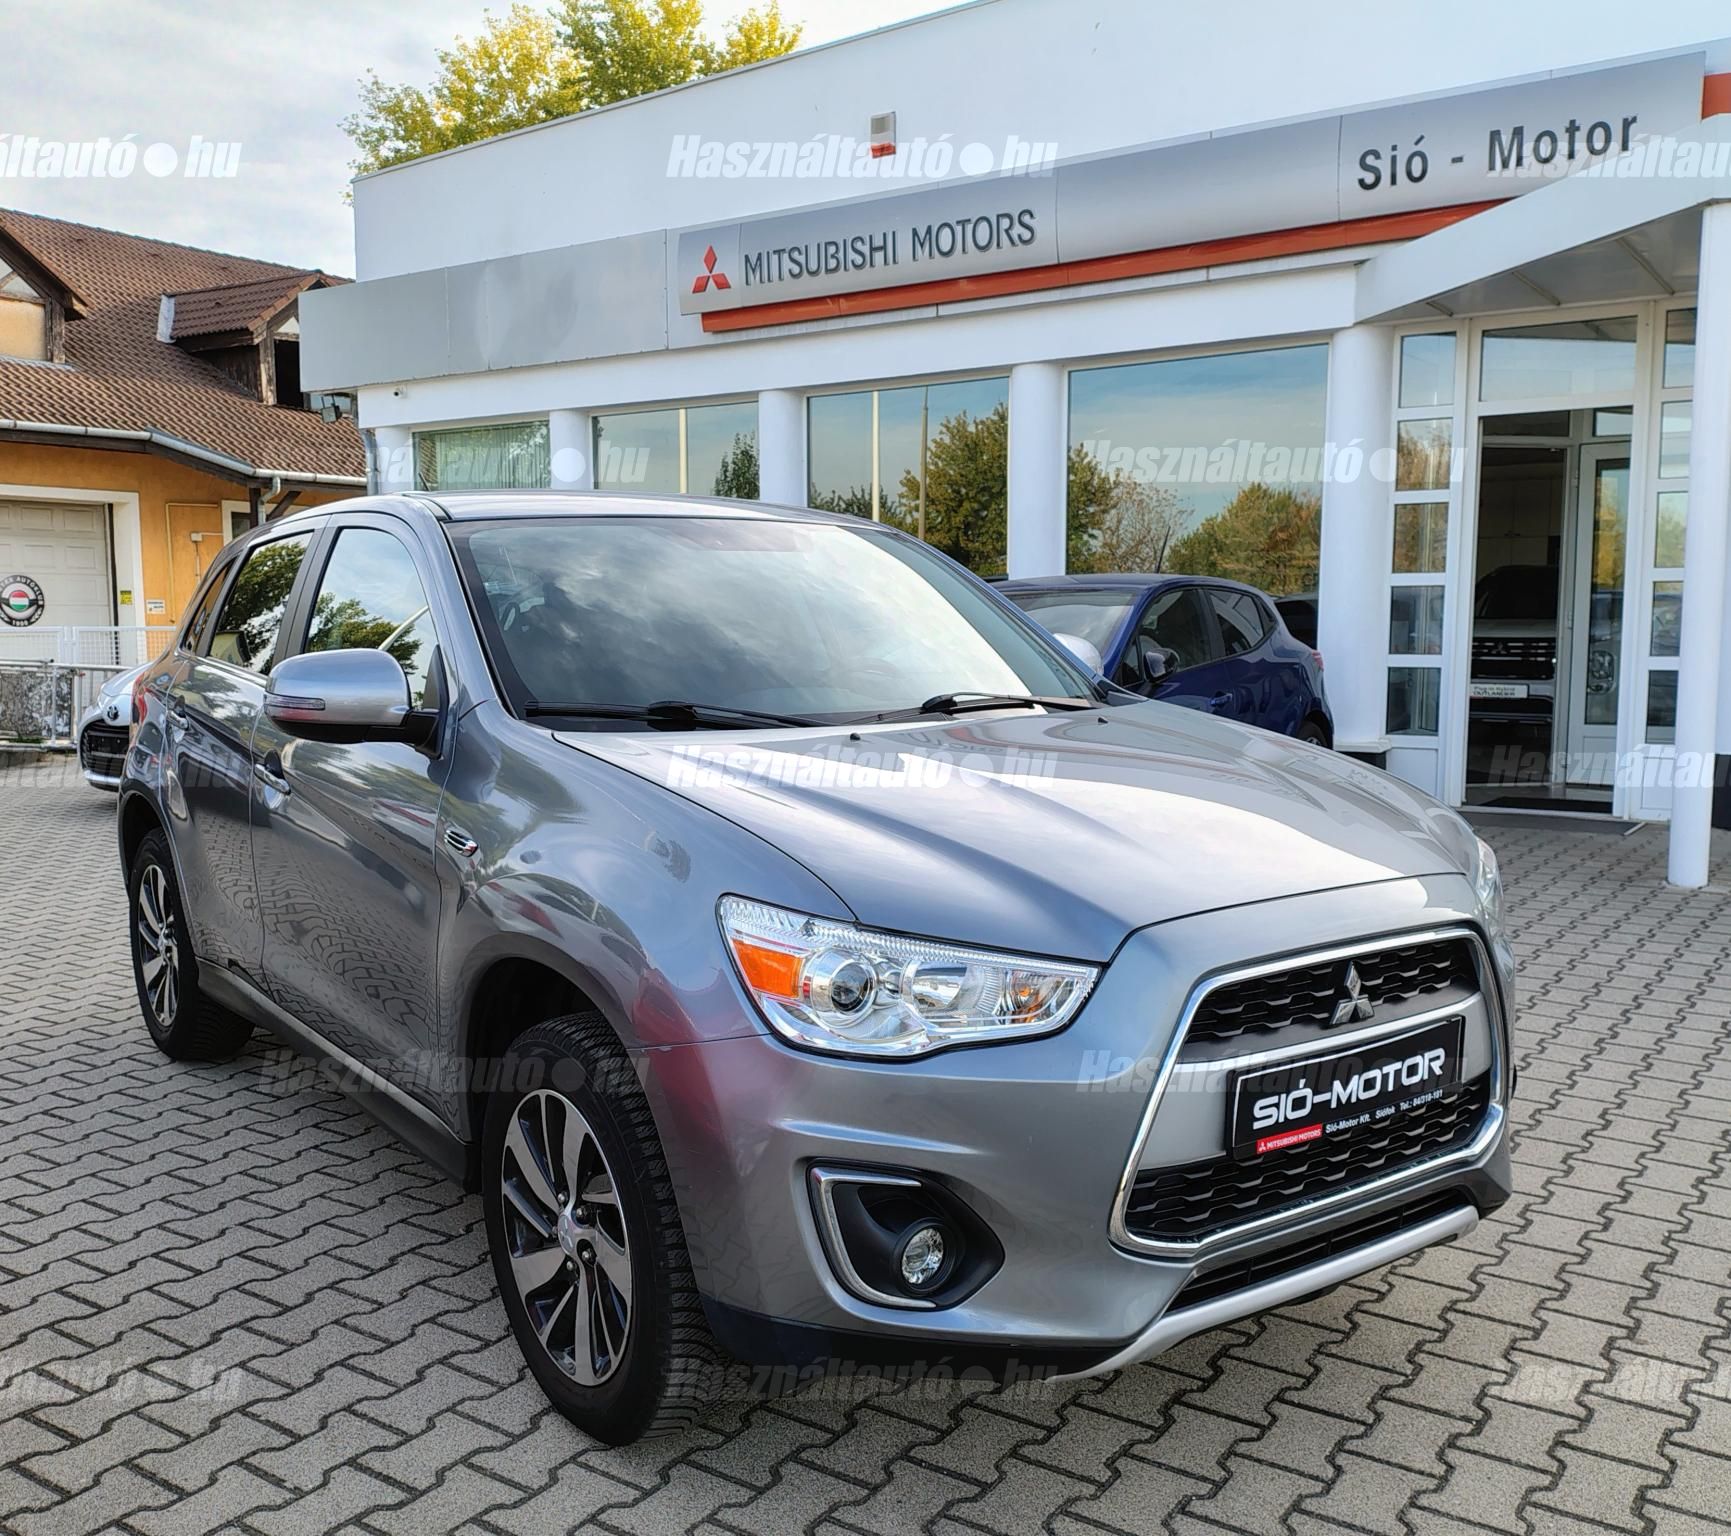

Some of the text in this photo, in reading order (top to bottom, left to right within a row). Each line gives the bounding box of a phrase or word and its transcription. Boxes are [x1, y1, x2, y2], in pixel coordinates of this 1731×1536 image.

[1357, 134, 1429, 191] Sió
[1488, 115, 1638, 171] Motor
[744, 209, 1036, 287] MITSUBISHI MOTORS
[1252, 1047, 1445, 1130] SIÓ-MOTOR
[1325, 1118, 1359, 1134] Sió-Motor
[1375, 1105, 1396, 1119] Siófok
[1266, 1128, 1321, 1150] MITSUBISHI MOTORS
